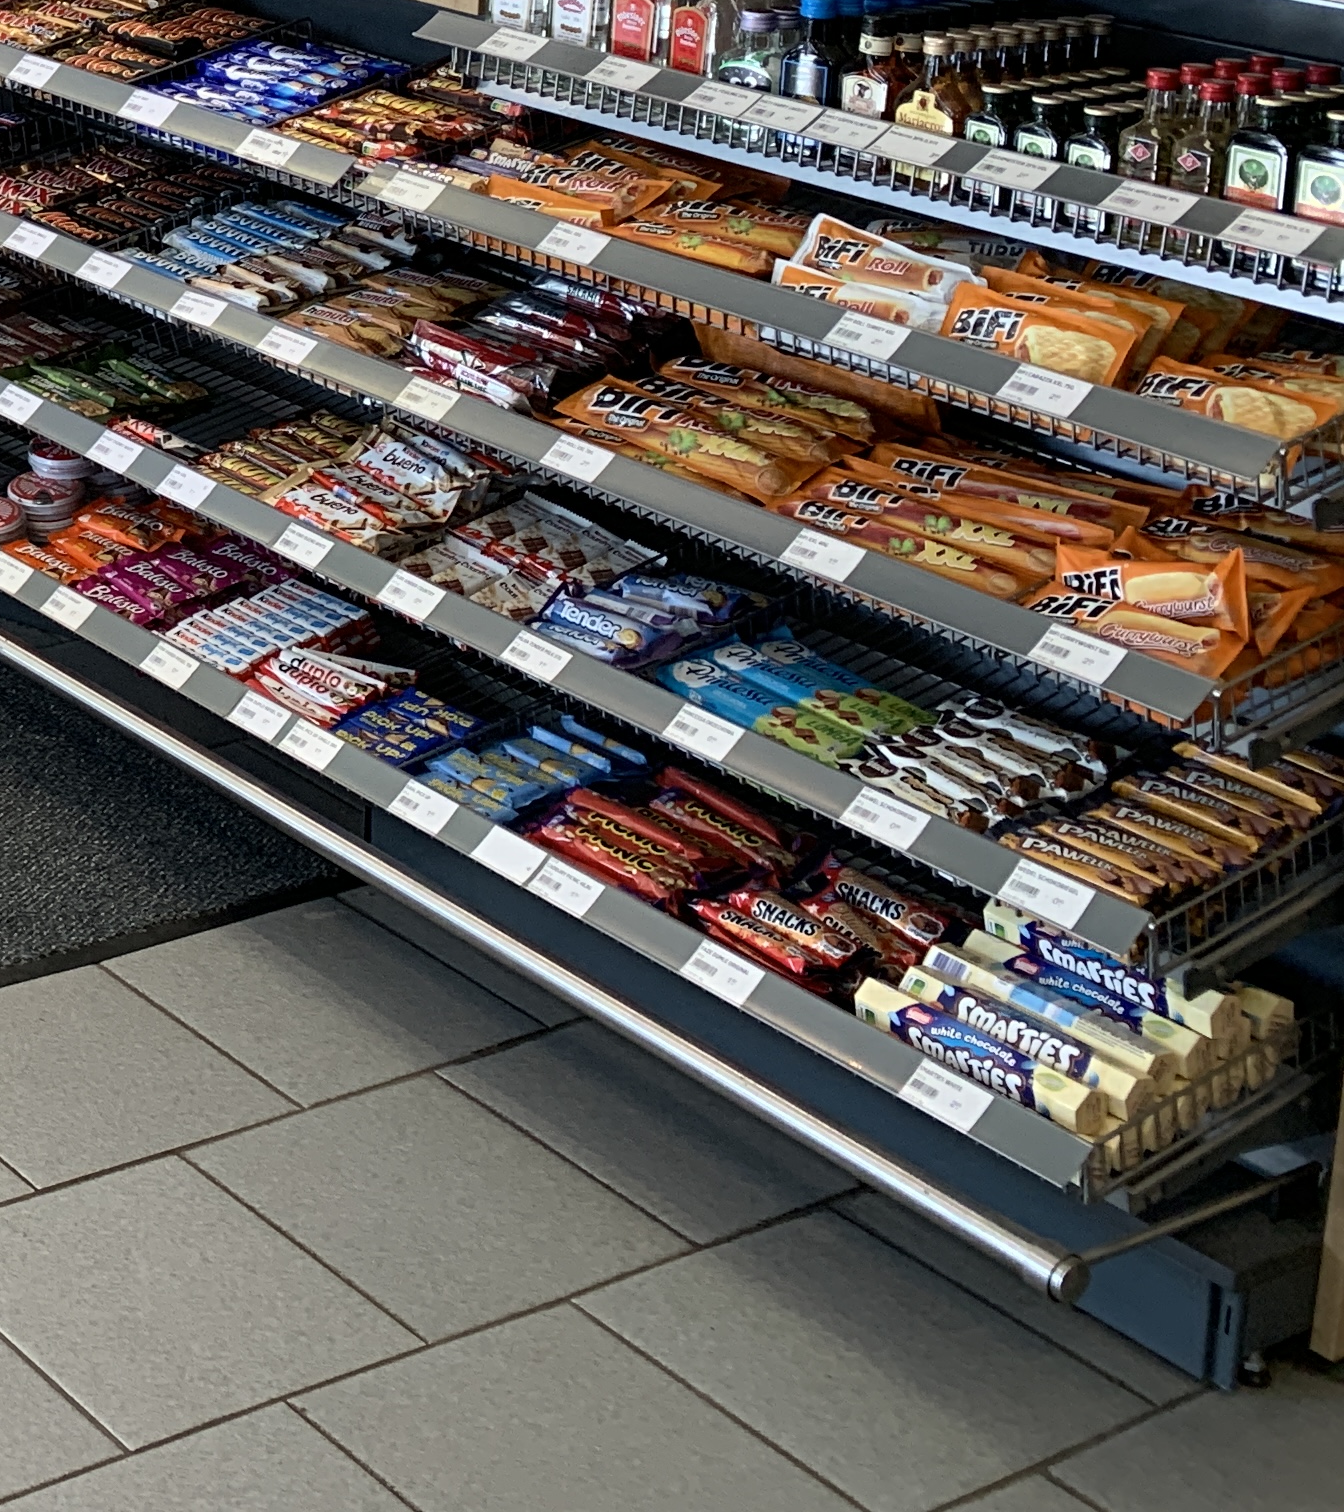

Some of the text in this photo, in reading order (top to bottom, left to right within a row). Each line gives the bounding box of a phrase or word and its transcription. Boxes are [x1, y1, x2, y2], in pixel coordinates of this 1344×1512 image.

[866, 257, 912, 276] Roll
[303, 304, 354, 324] hanuta
[350, 291, 400, 306] hanuta
[951, 306, 1028, 340] BiFi
[383, 448, 426, 474] bueno
[311, 492, 359, 515] bueno
[15, 542, 77, 575] Balisto
[167, 548, 228, 579] Balisto
[125, 560, 183, 594] Balisto
[83, 584, 146, 615] Balisto
[562, 599, 622, 639] Tender
[1098, 622, 1204, 658] Currywurst
[291, 657, 341, 688] duplo
[728, 646, 816, 689] Princessa
[686, 664, 776, 707] Princessa
[363, 710, 435, 741] PICK UP!
[806, 720, 861, 746] LONGA
[575, 826, 658, 872] PICNIC
[751, 899, 822, 937] SNACKS
[835, 882, 906, 920] SNACKS
[1037, 938, 1156, 1011] SMARTIES
[1038, 974, 1125, 1016] white chocolate
[930, 1025, 1017, 1067] white chocolate
[957, 996, 1080, 1072] SMARTIES
[908, 1026, 1023, 1103] SMARTIES
